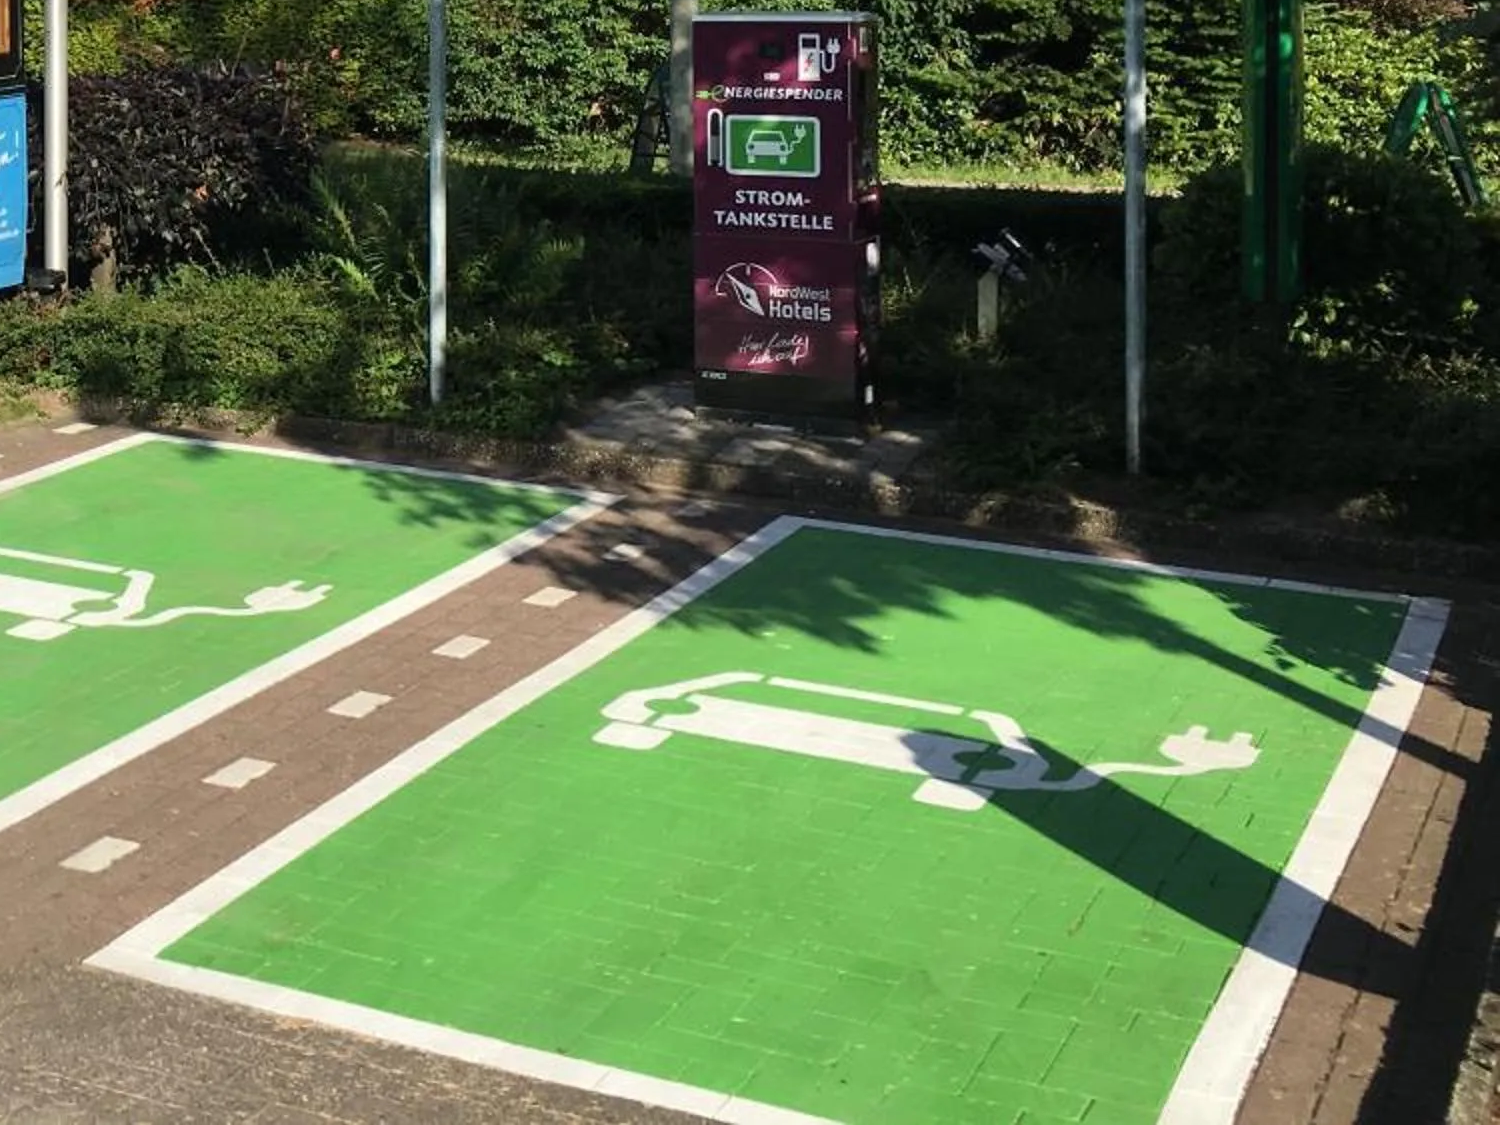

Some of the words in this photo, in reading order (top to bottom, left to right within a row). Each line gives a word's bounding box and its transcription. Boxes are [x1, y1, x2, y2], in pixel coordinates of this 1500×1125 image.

[735, 189, 811, 207] STROM-
[713, 210, 834, 230] TANKSTELLE
[769, 285, 831, 301] NordWest
[769, 300, 832, 322] Hotels
